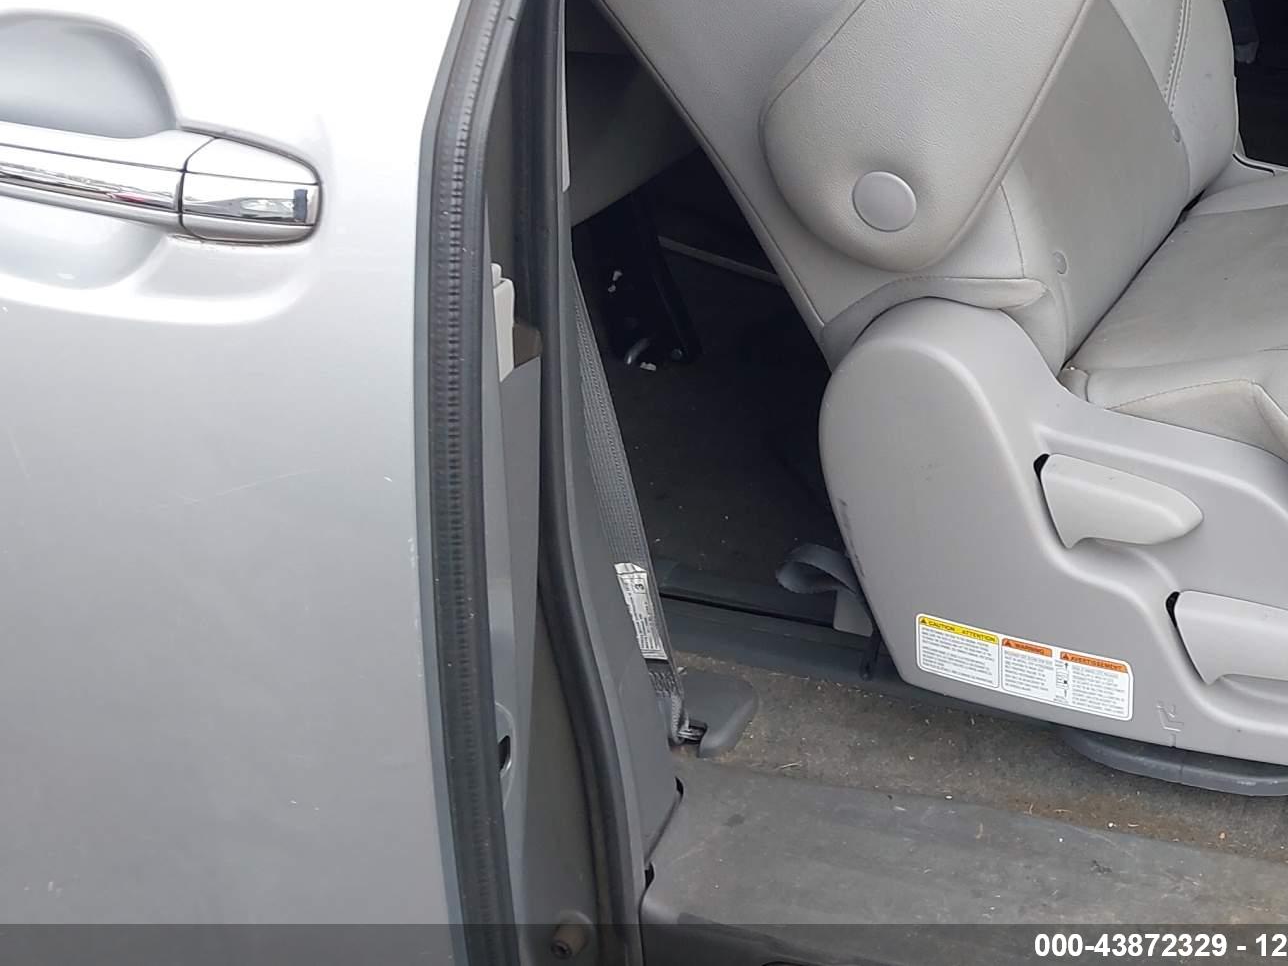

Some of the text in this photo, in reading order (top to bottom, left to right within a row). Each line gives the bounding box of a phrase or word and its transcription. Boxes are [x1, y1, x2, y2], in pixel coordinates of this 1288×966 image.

[928, 620, 996, 643] CAUTION ATTENTION
[1015, 642, 1045, 655] WARNING
[1070, 656, 1123, 671] AVERTISSEMENT
